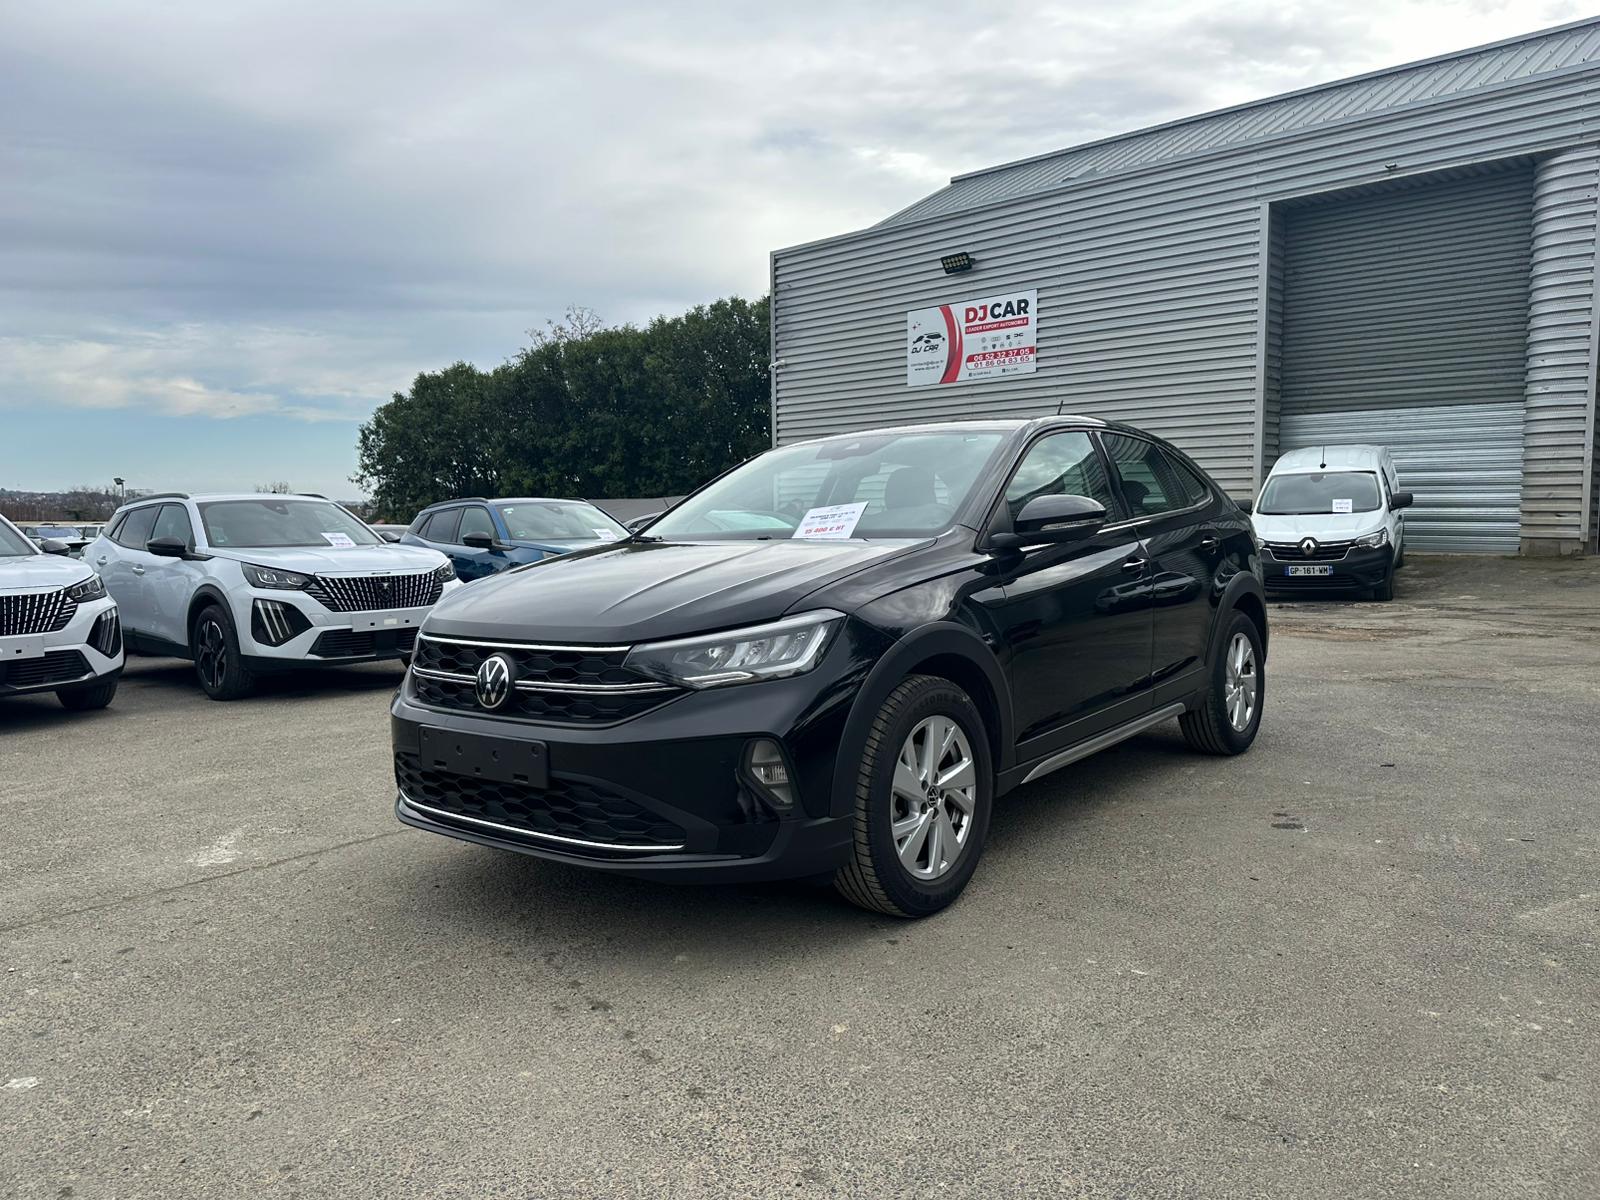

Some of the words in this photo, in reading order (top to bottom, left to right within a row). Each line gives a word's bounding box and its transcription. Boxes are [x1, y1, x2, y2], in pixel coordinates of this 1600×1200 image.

[965, 305, 988, 323] DJ
[990, 299, 1029, 319] CAR
[1000, 319, 1028, 327] AUTOMOBILE
[911, 346, 923, 354] DJ
[923, 344, 940, 352] CAR
[1007, 349, 1018, 357] 37
[1290, 566, 1328, 575] GP-161-WM
